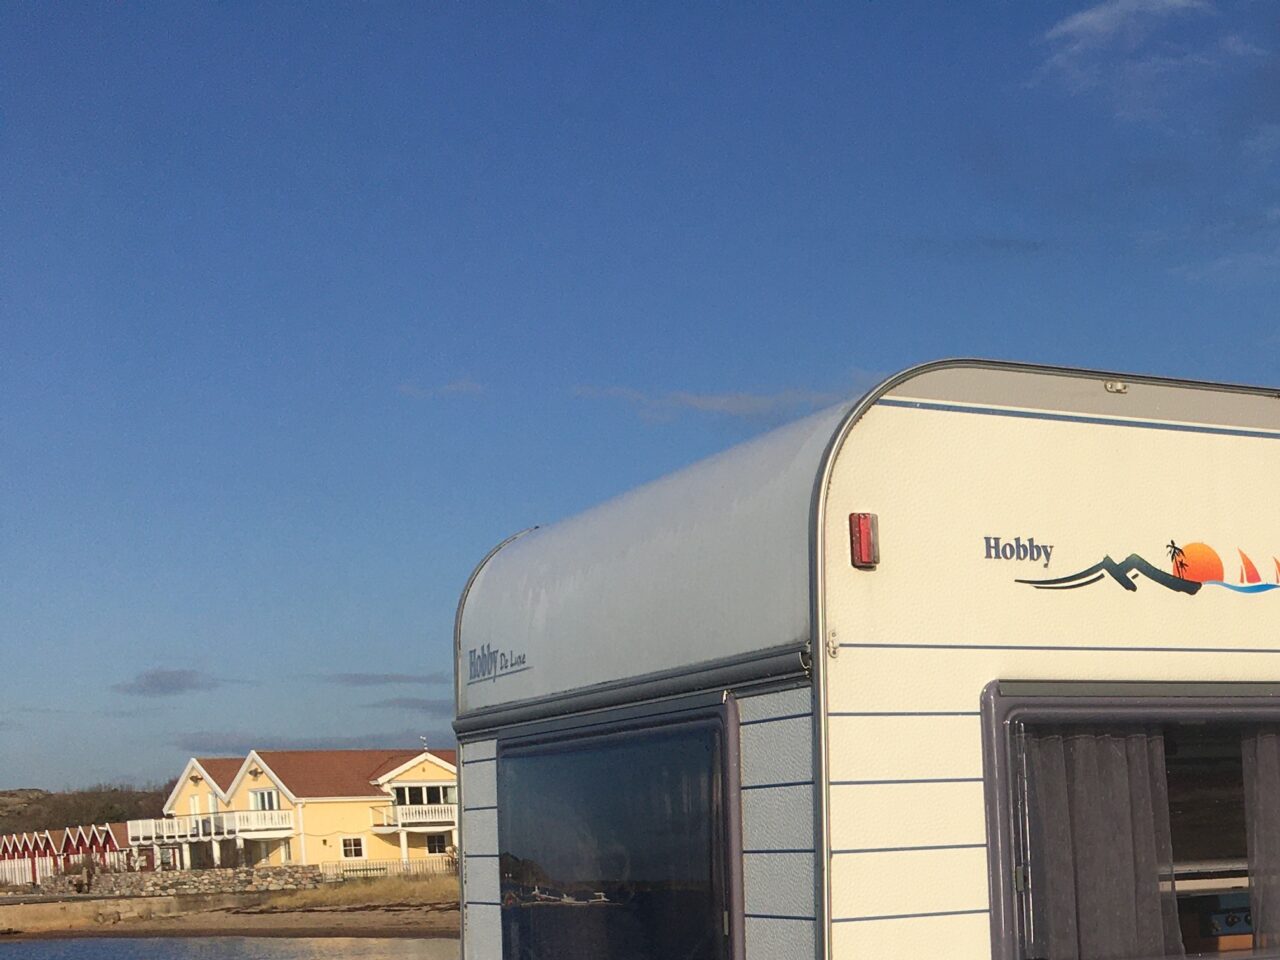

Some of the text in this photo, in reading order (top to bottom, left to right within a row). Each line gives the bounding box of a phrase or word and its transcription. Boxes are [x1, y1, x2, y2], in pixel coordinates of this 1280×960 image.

[984, 536, 1054, 568] Hobby
[469, 643, 499, 683] Hobby
[500, 652, 509, 670] De
